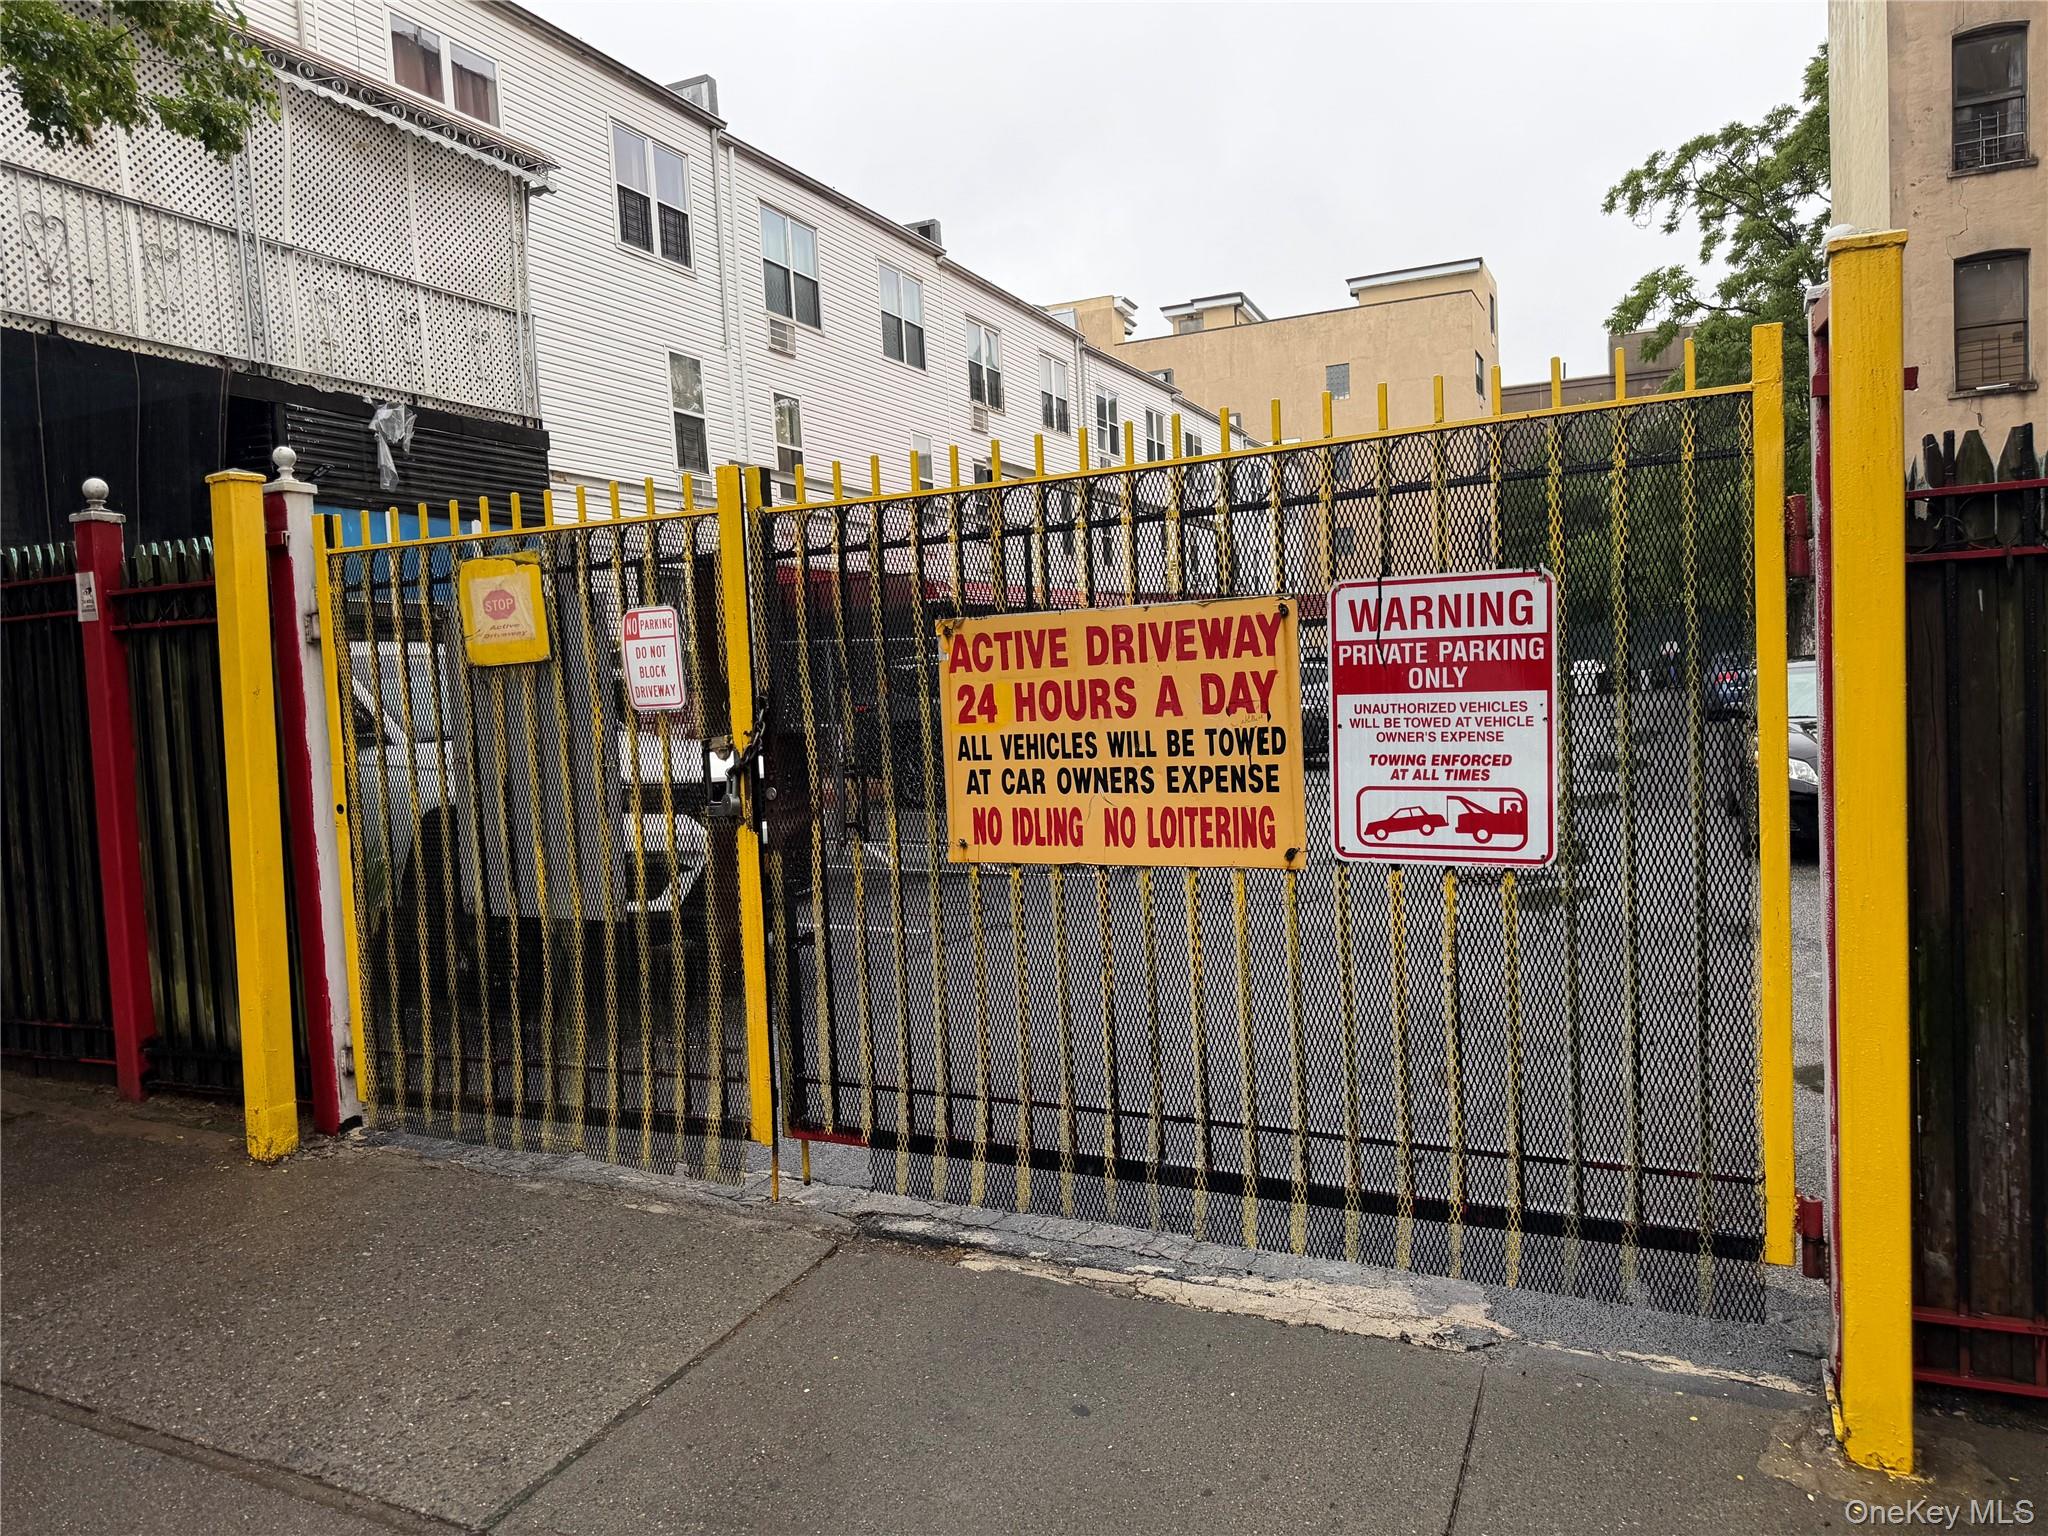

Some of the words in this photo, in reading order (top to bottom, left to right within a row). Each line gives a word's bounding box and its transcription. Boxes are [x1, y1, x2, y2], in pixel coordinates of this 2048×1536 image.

[485, 598, 513, 612] STOP
[1348, 590, 1534, 632] WARNING
[626, 617, 638, 635] NO
[640, 617, 672, 630] PARKING
[949, 627, 1068, 673] ACTIVE
[1086, 612, 1282, 666] DRIVEWAY
[635, 646, 647, 658] DO
[650, 645, 666, 658] NOT
[1338, 643, 1427, 666] PRIVATE
[1439, 637, 1544, 662] PARKING
[639, 665, 666, 678] BLOCK
[1408, 666, 1468, 689] ONLY
[635, 683, 676, 698] DRIVEWAY
[958, 684, 998, 723] 24
[1015, 677, 1137, 721] HOURS
[1155, 675, 1183, 716] A
[1201, 670, 1277, 715] DAY
[1354, 702, 1456, 714] UNAUTHORIZED
[1460, 701, 1528, 713] VEHICLES
[1349, 718, 1380, 729] WILL
[1384, 718, 1400, 728] BE
[1403, 717, 1450, 728] TOWED
[1455, 716, 1472, 727] AT
[1475, 716, 1534, 727] VEHICLE
[958, 735, 992, 761] ALL
[1000, 731, 1097, 760] VEHICLES
[1107, 729, 1156, 758] WILL
[1167, 728, 1195, 756] BE
[1205, 726, 1286, 756] TOWED
[1376, 731, 1437, 743] OWNER'S
[1441, 730, 1504, 742] EXPENSE
[1369, 754, 1426, 766] TOWING
[1431, 754, 1512, 766] ENFORCED
[966, 768, 991, 795] AT
[1001, 767, 1045, 794] CAR
[1057, 766, 1154, 794] OWNERS
[1167, 764, 1279, 793] EXPENSE
[1390, 770, 1408, 780] AT
[1413, 770, 1439, 780] ALL
[1444, 769, 1490, 781] TIMES
[972, 807, 1002, 846] NO
[1013, 807, 1083, 847] IDLING
[1105, 806, 1135, 847] NO
[1148, 806, 1276, 849] LOITERING
